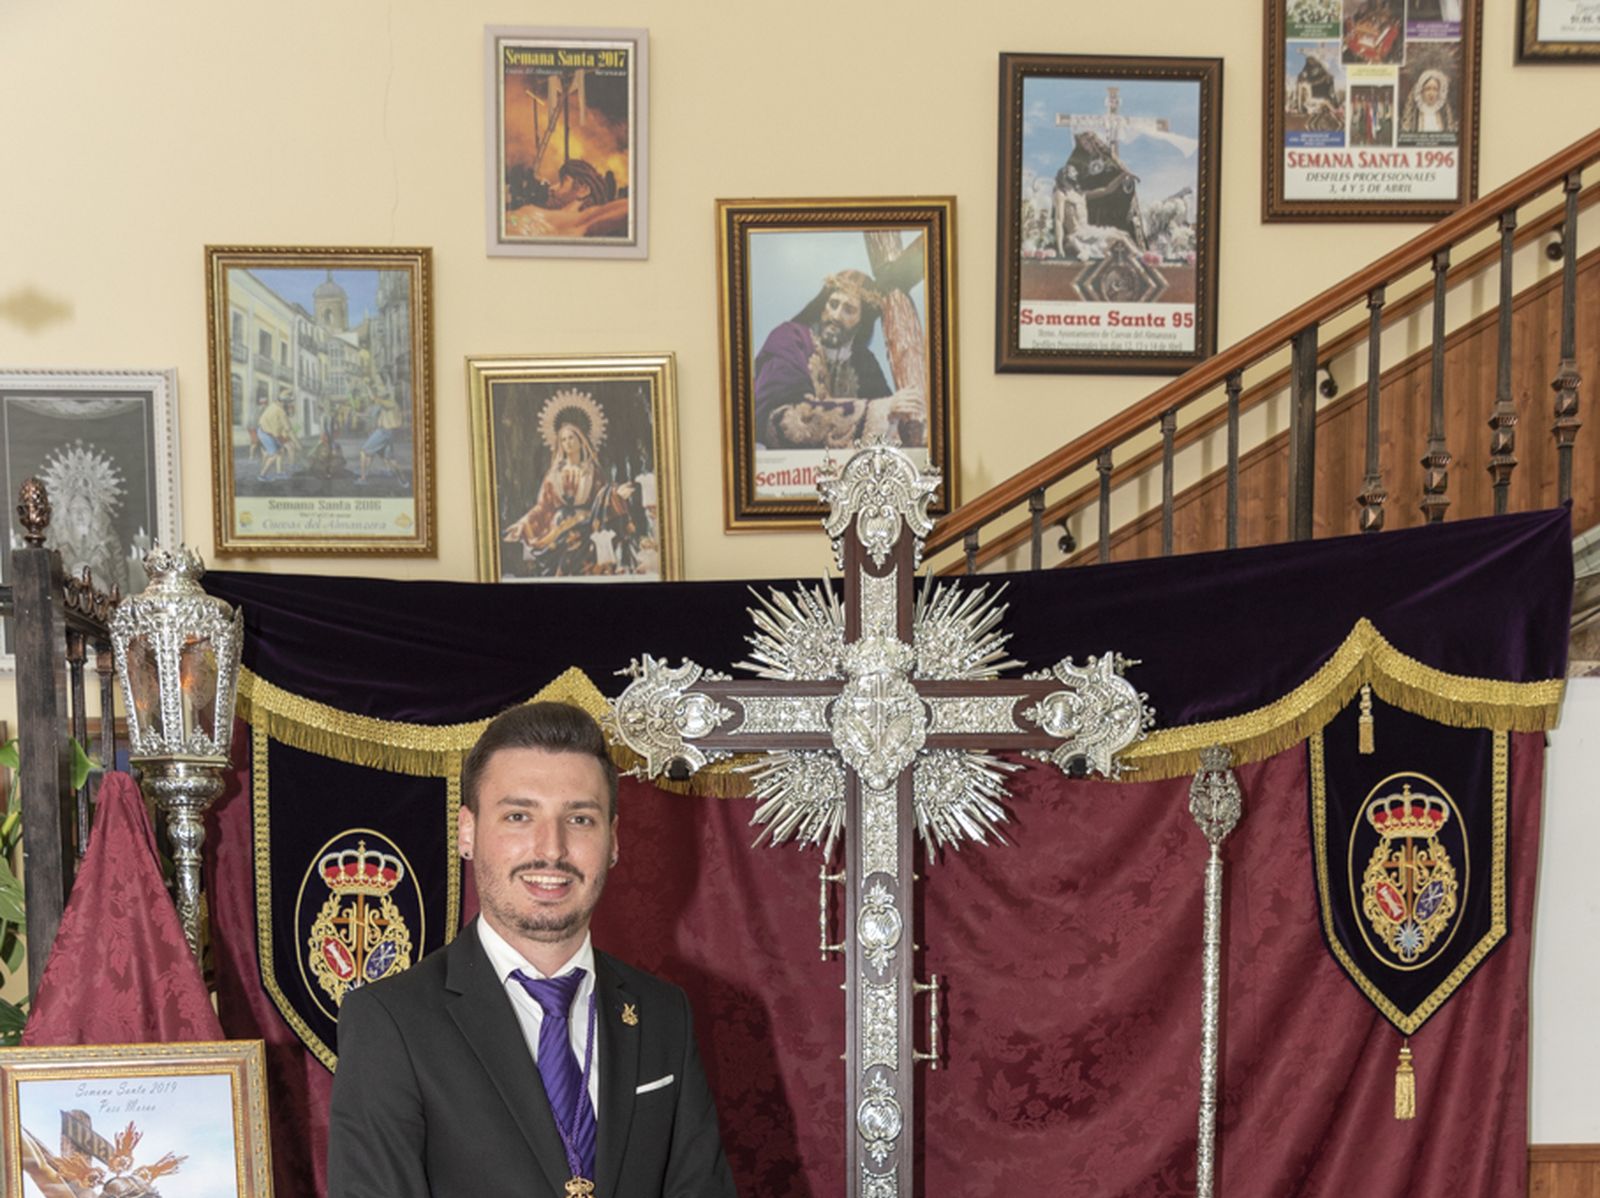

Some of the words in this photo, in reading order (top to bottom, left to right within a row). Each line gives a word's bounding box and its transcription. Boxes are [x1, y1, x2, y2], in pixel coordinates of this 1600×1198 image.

[505, 48, 554, 66] Semana
[558, 49, 595, 67] Santa
[597, 51, 627, 68] 2017
[1415, 151, 1455, 169] 1996
[1306, 172, 1350, 182] DESFILES
[1353, 171, 1436, 182] PROCESIONALES
[1340, 184, 1347, 194] 4
[1349, 184, 1356, 194] Y
[1359, 184, 1365, 194] 5
[1367, 184, 1381, 194] DE
[1384, 184, 1413, 194] ABRIL
[1020, 308, 1101, 327] Semana
[1107, 310, 1166, 328] Santa
[1172, 311, 1194, 329] 95
[268, 499, 314, 511] Semana
[318, 499, 351, 511] Santa
[355, 500, 382, 511] 2016
[75, 1082, 113, 1098] Semana
[116, 1081, 147, 1096] Santa
[149, 1080, 178, 1095] 2019
[99, 1099, 121, 1113] Paso
